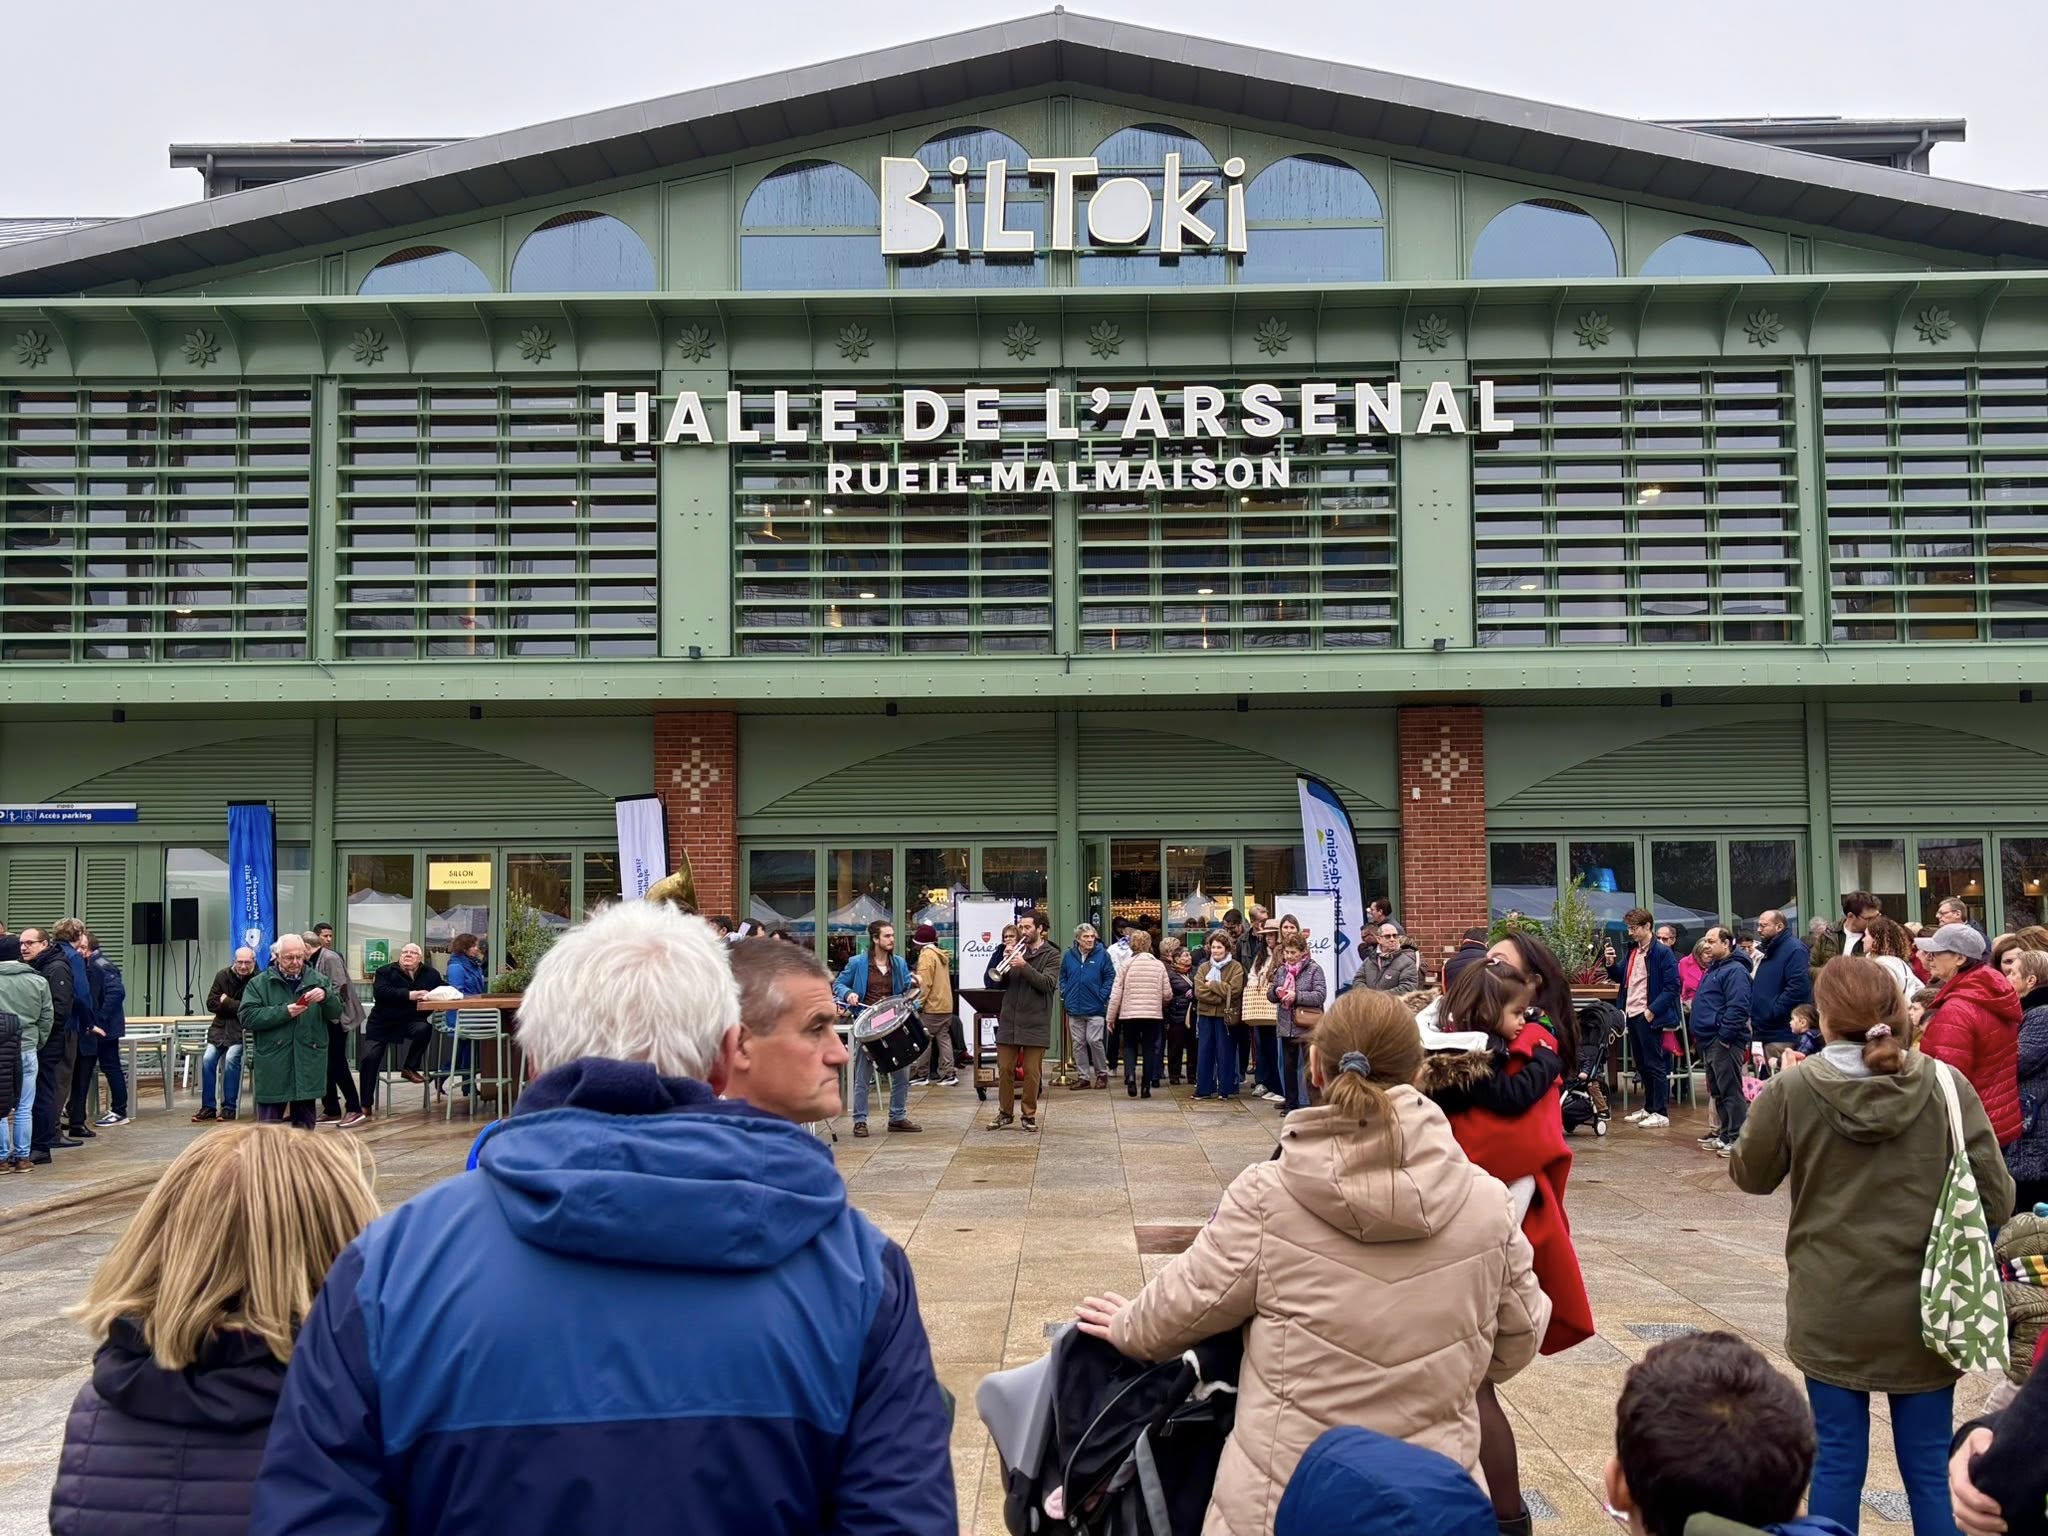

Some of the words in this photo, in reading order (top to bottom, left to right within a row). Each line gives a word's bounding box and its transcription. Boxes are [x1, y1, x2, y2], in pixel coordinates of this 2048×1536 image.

[603, 389, 858, 444] HALLE
[903, 388, 1001, 442] DE
[1046, 380, 1514, 440] L'ARSENAL
[827, 456, 1291, 495] RUEIL-MALMAISON
[38, 811, 60, 819] Accès
[61, 811, 92, 820] parking
[448, 870, 474, 878] SILLON
